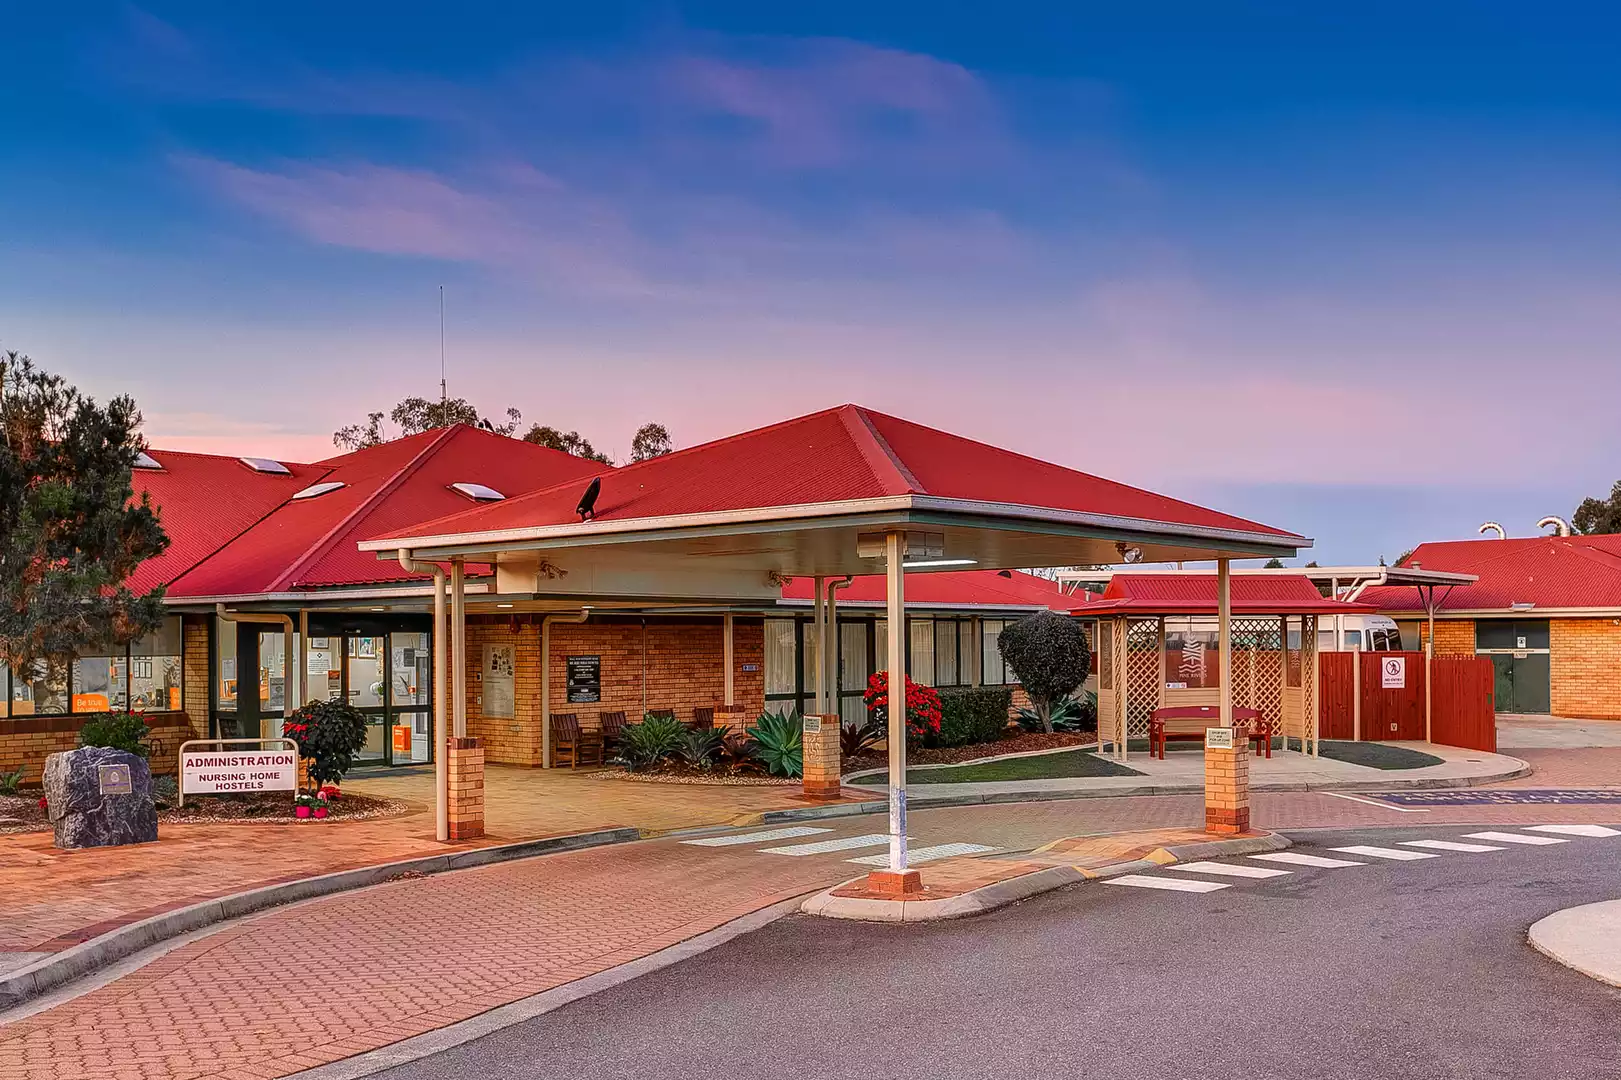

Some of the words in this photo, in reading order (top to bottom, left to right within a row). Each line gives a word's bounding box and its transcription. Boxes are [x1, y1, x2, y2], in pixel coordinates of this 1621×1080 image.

[77, 698, 86, 707] Be
[186, 755, 293, 768] ADMINISTRATION
[199, 773, 246, 782] NURSING
[250, 772, 280, 780] HOME
[215, 782, 264, 790] HOSTELS
